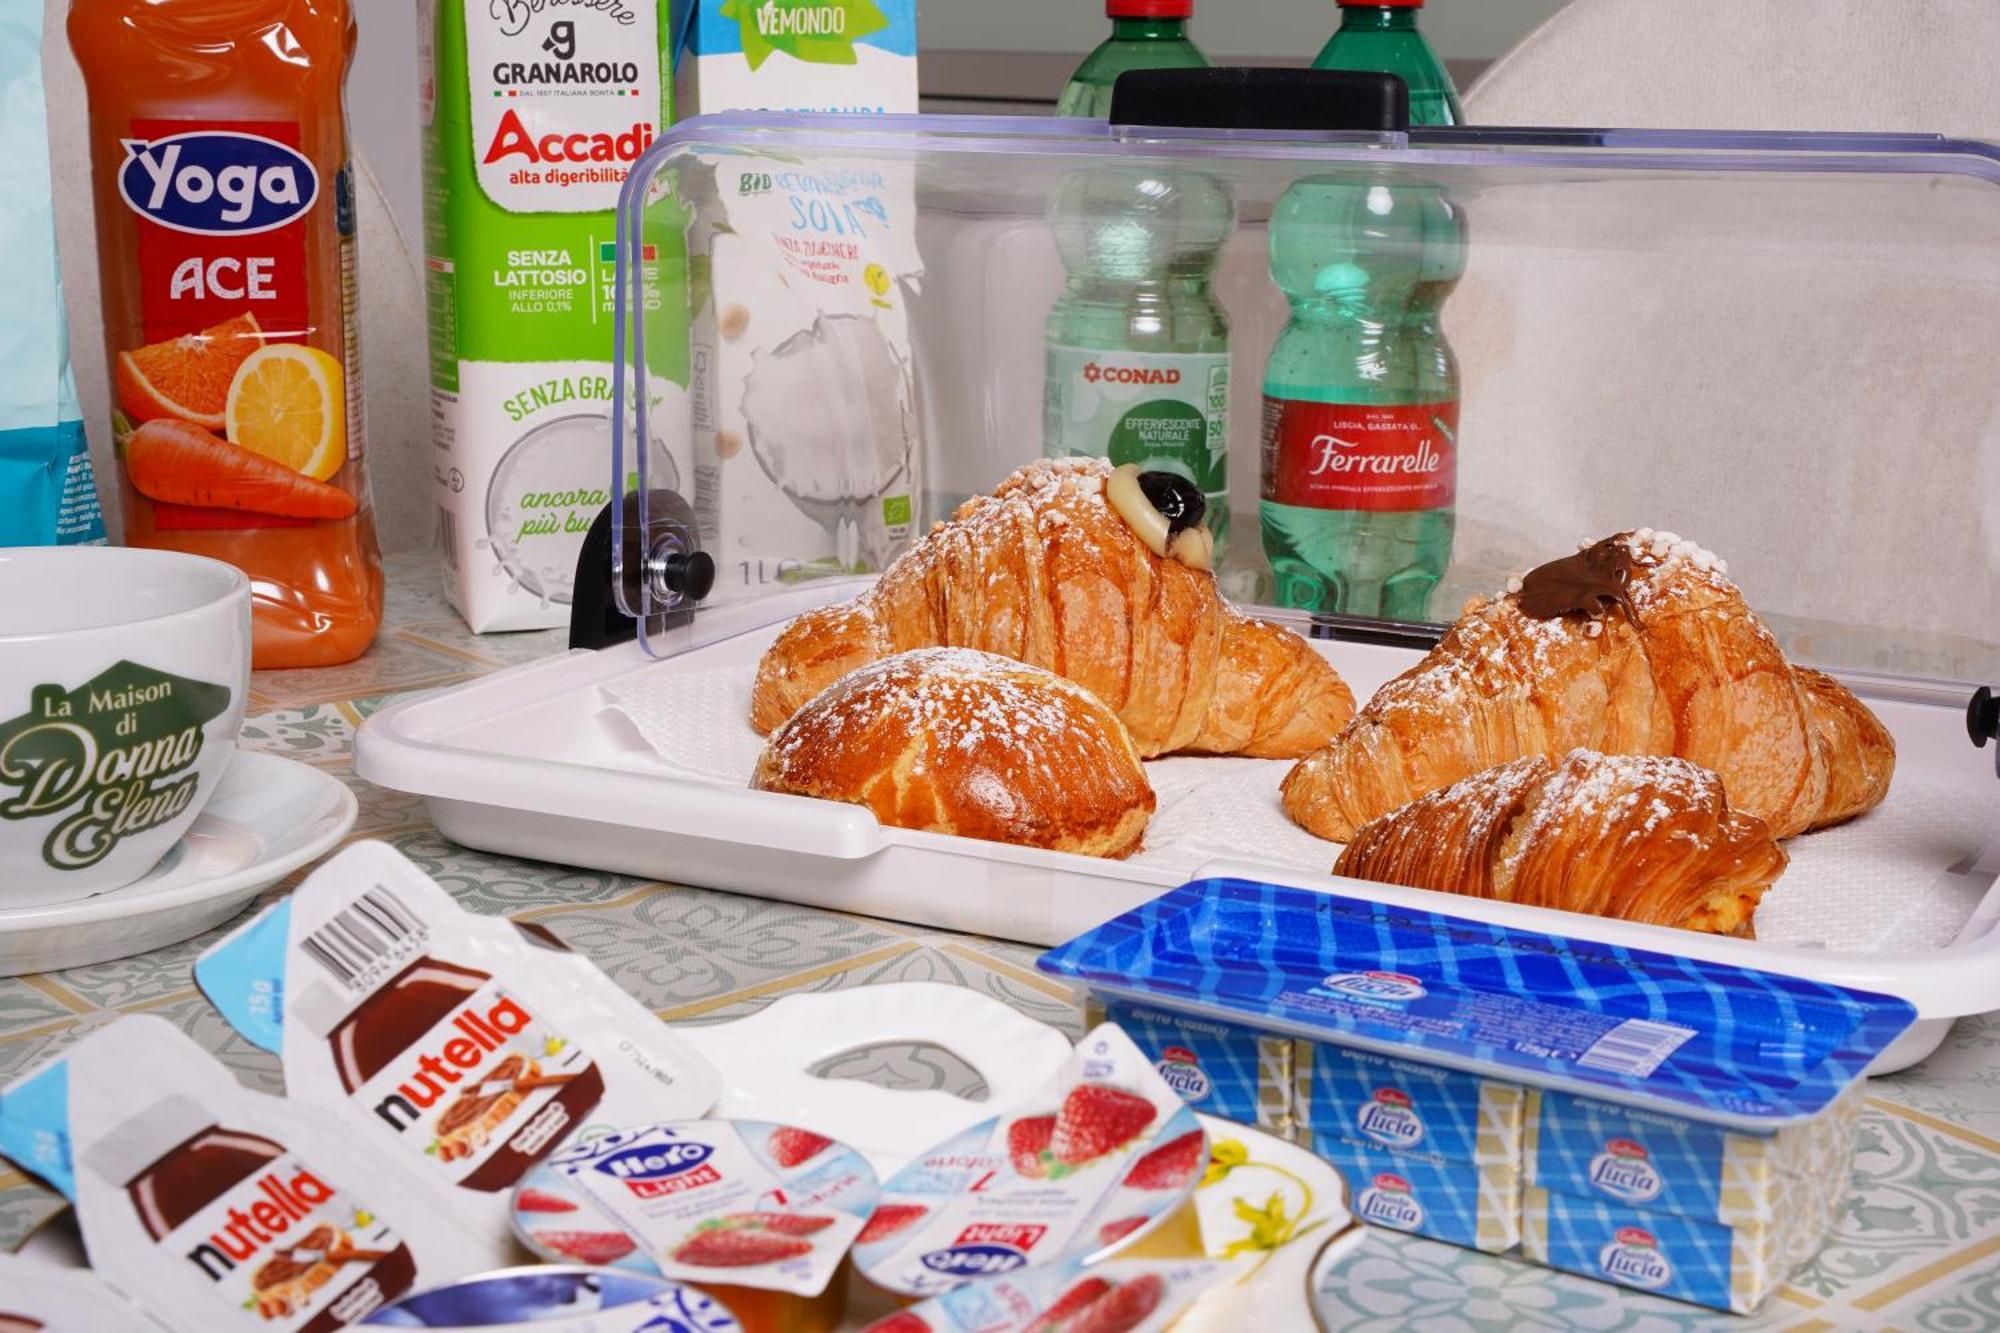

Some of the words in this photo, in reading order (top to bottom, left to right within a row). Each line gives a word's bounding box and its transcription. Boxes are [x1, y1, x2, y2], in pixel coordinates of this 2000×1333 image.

[756, 5, 845, 36] VEMONDO
[493, 62, 639, 84] GRANAROLO
[554, 89, 587, 97] ITALIANA
[135, 144, 300, 223] Yoga
[510, 170, 540, 184] alta
[545, 167, 628, 187] digeribilità
[507, 250, 572, 267] SENZA
[169, 256, 277, 300] ACE
[494, 269, 587, 287] LATTOSIO
[508, 288, 574, 301] INFERIORE
[511, 302, 542, 313] ALLO
[1102, 367, 1182, 385] CONAD
[503, 378, 577, 422] SENZA
[1125, 418, 1201, 430] EFFERVESCENTE
[1139, 430, 1191, 441] NATURALE
[1367, 422, 1408, 431] GASSATA
[1308, 434, 1440, 475] Ferrarelle
[521, 488, 608, 509] ancora
[512, 512, 562, 544] più
[44, 697, 72, 718] La
[88, 682, 172, 714] Maison
[115, 713, 138, 736] di
[1, 722, 200, 813] Donna
[51, 779, 197, 866] Elena
[373, 996, 533, 1133] nutella
[610, 1144, 705, 1178] Hero
[636, 1168, 714, 1198] Light
[186, 1169, 335, 1281] nutella
[963, 1225, 1043, 1246] Light
[923, 1249, 1022, 1273] Hero
